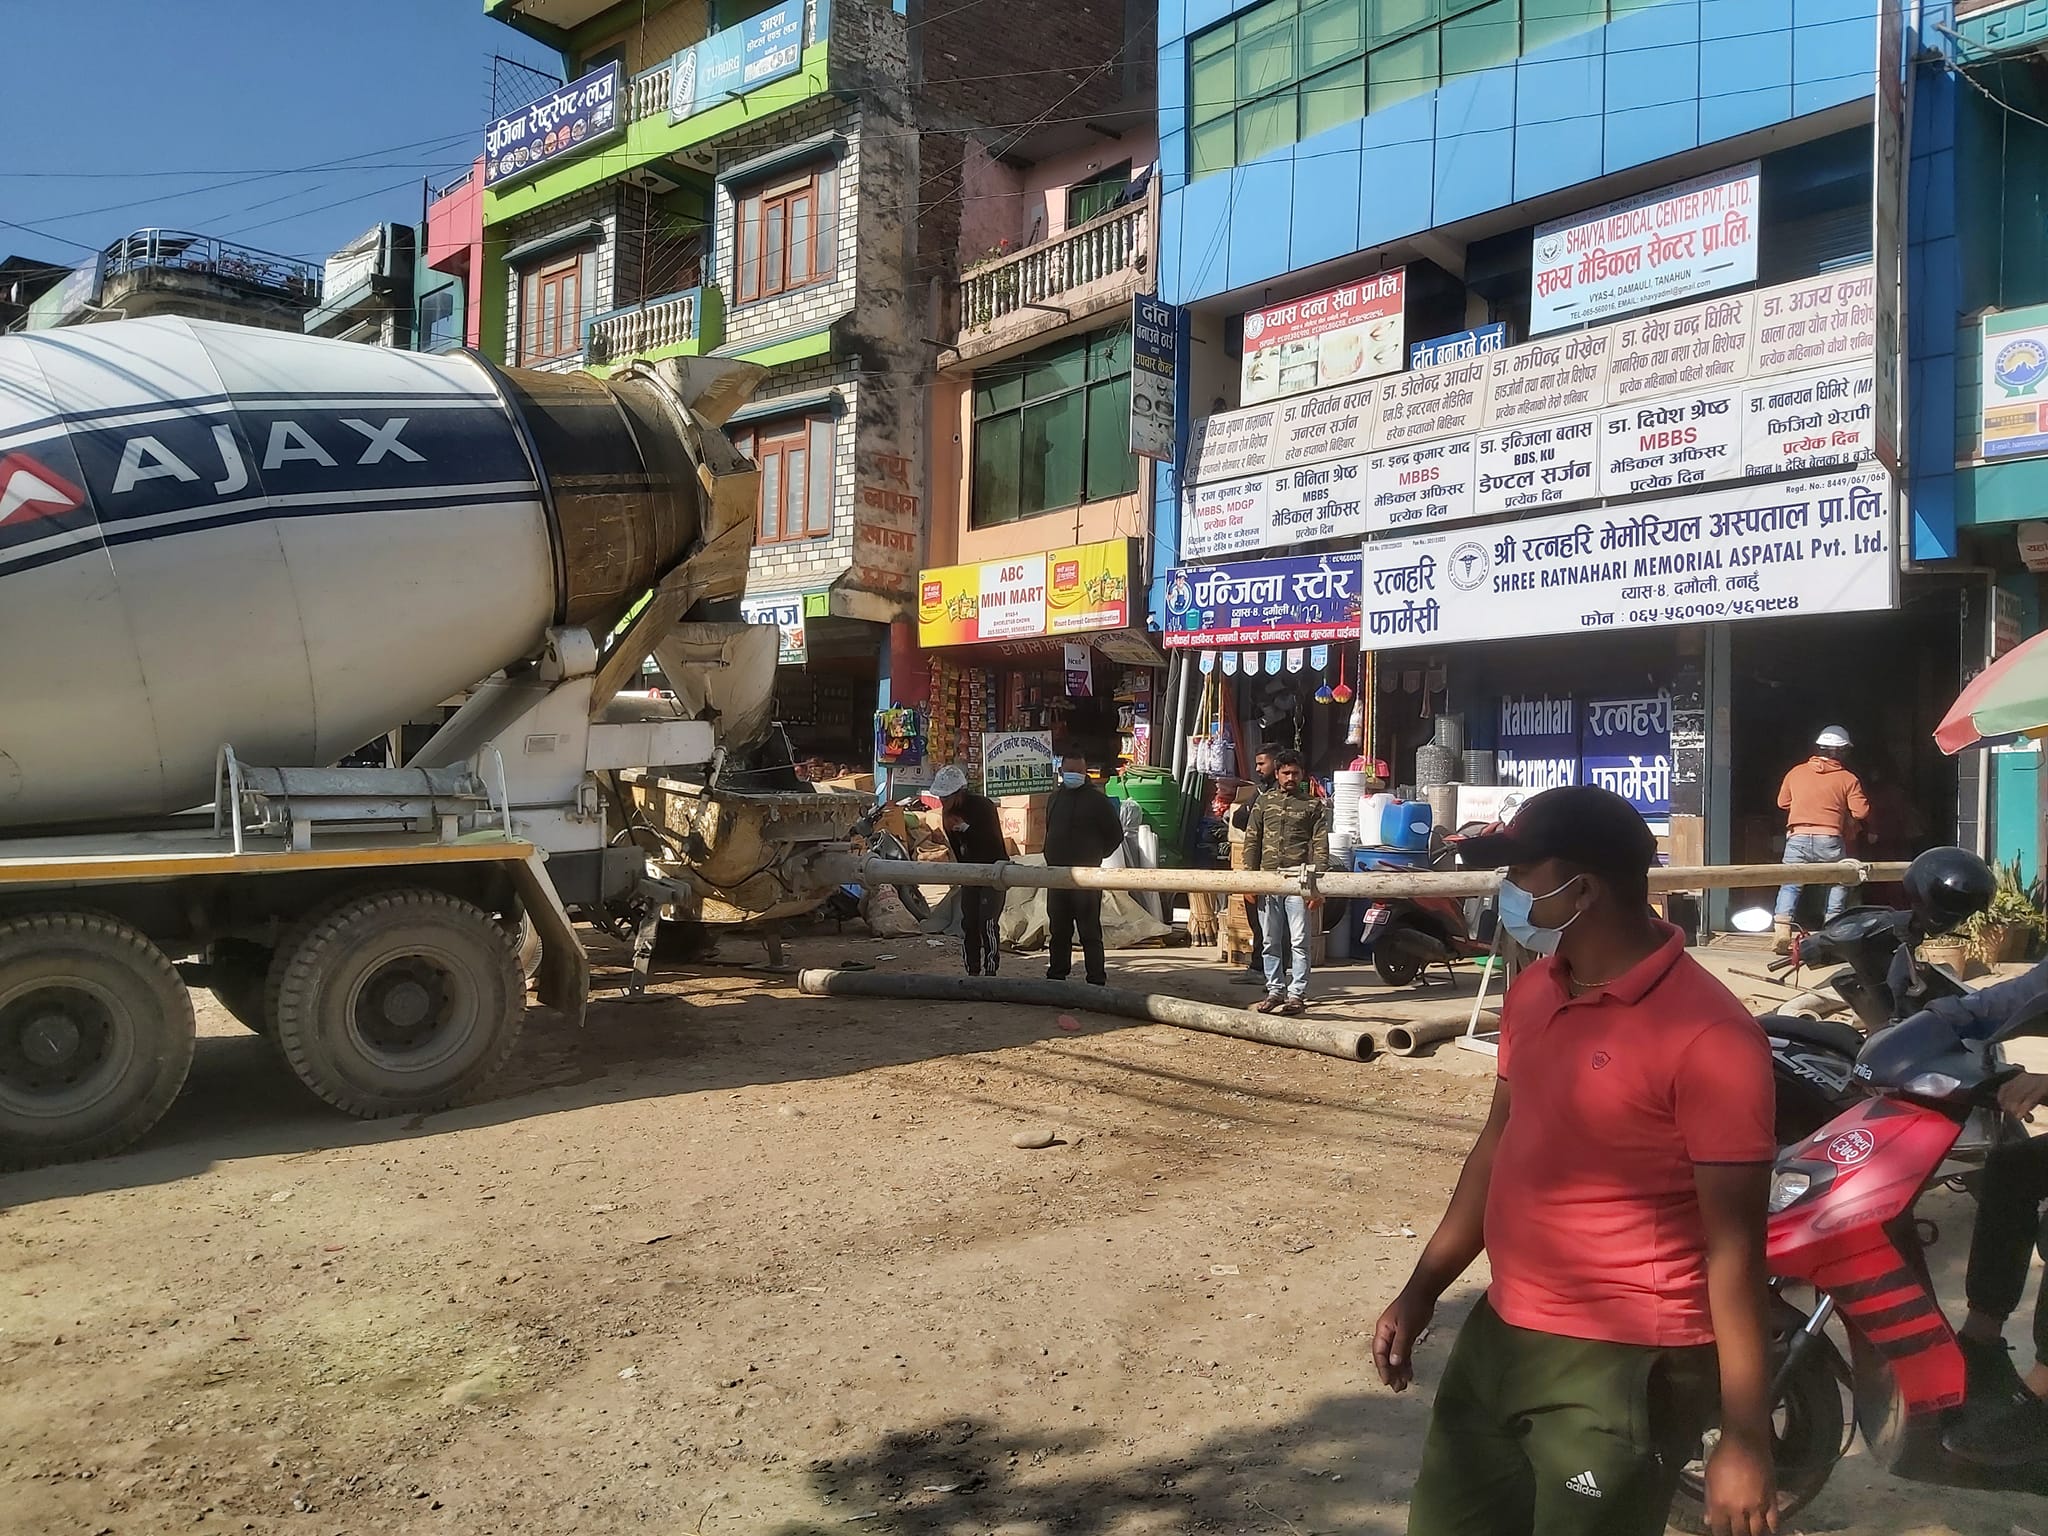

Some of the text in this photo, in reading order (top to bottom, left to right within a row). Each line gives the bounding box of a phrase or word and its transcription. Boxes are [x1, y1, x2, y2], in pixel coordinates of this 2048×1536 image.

[760, 11, 785, 32] आशा
[707, 56, 740, 80] TUBORG
[586, 74, 613, 107] लज
[1566, 216, 1604, 254] SHAVYA
[1608, 206, 1652, 242] MEDICAL
[1656, 194, 1700, 228] CENTER
[1702, 186, 1725, 216] PVT.
[1728, 178, 1752, 206] LTD.
[1536, 264, 1574, 298] सभ्य
[1578, 245, 1642, 285] मेडिकल
[1648, 230, 1697, 268] सेन्टर
[1655, 269, 1692, 286] TANAHUN
[1266, 305, 1296, 328] व्यास
[1301, 296, 1328, 320] दन्त
[1332, 288, 1358, 310] सेवा
[1764, 284, 1834, 318] डा. अजय
[1142, 302, 1170, 328] दाँत
[1622, 301, 1744, 348] डा. देवेश चन्द्र घिमिरे
[1761, 309, 1848, 345] छाला तथा यौन रोग
[1413, 324, 1504, 370] दाँत बनाउने ठाउँ
[1611, 338, 1711, 375] मानसिक तथा रोग
[1493, 359, 1509, 377] डा.
[1284, 388, 1373, 422] डा. बराल
[1382, 384, 1398, 401] डा.
[1750, 376, 1850, 414] डा. नवनयन घिमिरे
[1290, 413, 1358, 442] जनरल सर्जन
[1608, 398, 1730, 436] डा. दिपेश श्रेष्ठ
[1768, 404, 1872, 436] फिजियो थेरापी
[1480, 421, 1592, 455] डा. इन्जिला बतास
[1640, 427, 1698, 452] MBBS
[1783, 430, 1860, 456] प्रत्येक दिन
[111, 417, 428, 496] AJAX
[1284, 445, 1302, 461] हरेक
[1371, 448, 1445, 470] डा. इन्द्र कुमार
[1514, 448, 1556, 467] BDS, KU
[1610, 443, 1728, 474] मेडिकल अफिसर
[1276, 464, 1358, 493] डा. विनिता श्रेष्ठ
[1399, 466, 1440, 486] MBBS
[1479, 460, 1592, 494] डेण्टल सर्जन
[1630, 468, 1706, 494] प्रत्येक दिन
[1786, 485, 1805, 495] Regd.
[1827, 472, 1886, 488] 8449/067/068
[1201, 485, 1242, 502] राम कुमार
[1227, 499, 1254, 514] MDGP
[1303, 489, 1329, 503] MBBS
[1374, 482, 1466, 508] मेडिकल अफिसर
[1505, 488, 1562, 508] प्रत्येक दिन
[1228, 514, 1244, 527] दिन
[1272, 499, 1362, 528] मेडिकल अफिसर
[1389, 504, 1448, 525] प्रत्येक दिन
[1296, 524, 1334, 540] प्रत्येक दिन
[1494, 535, 1516, 566] श्री
[1522, 524, 1594, 562] रत्नहरि
[1600, 514, 1702, 551] मेमोरियल
[1710, 501, 1810, 538] अस्पताल
[1000, 564, 1024, 584] ABC
[1374, 554, 1437, 596] रत्नहरि
[1494, 530, 1888, 594] SHREE RATNAHARI MEMORIAL ASPATAL Pvt. Ltd.
[1195, 564, 1354, 608] एन्जिला स्टोर
[1726, 569, 1760, 592] तनहुँ
[981, 586, 1044, 608] MINI MART
[1370, 598, 1440, 636] फार्मेसी
[1581, 608, 1615, 627] फोन
[1502, 692, 1572, 736] Ratnahari
[1566, 1481, 1602, 1498] adidas
